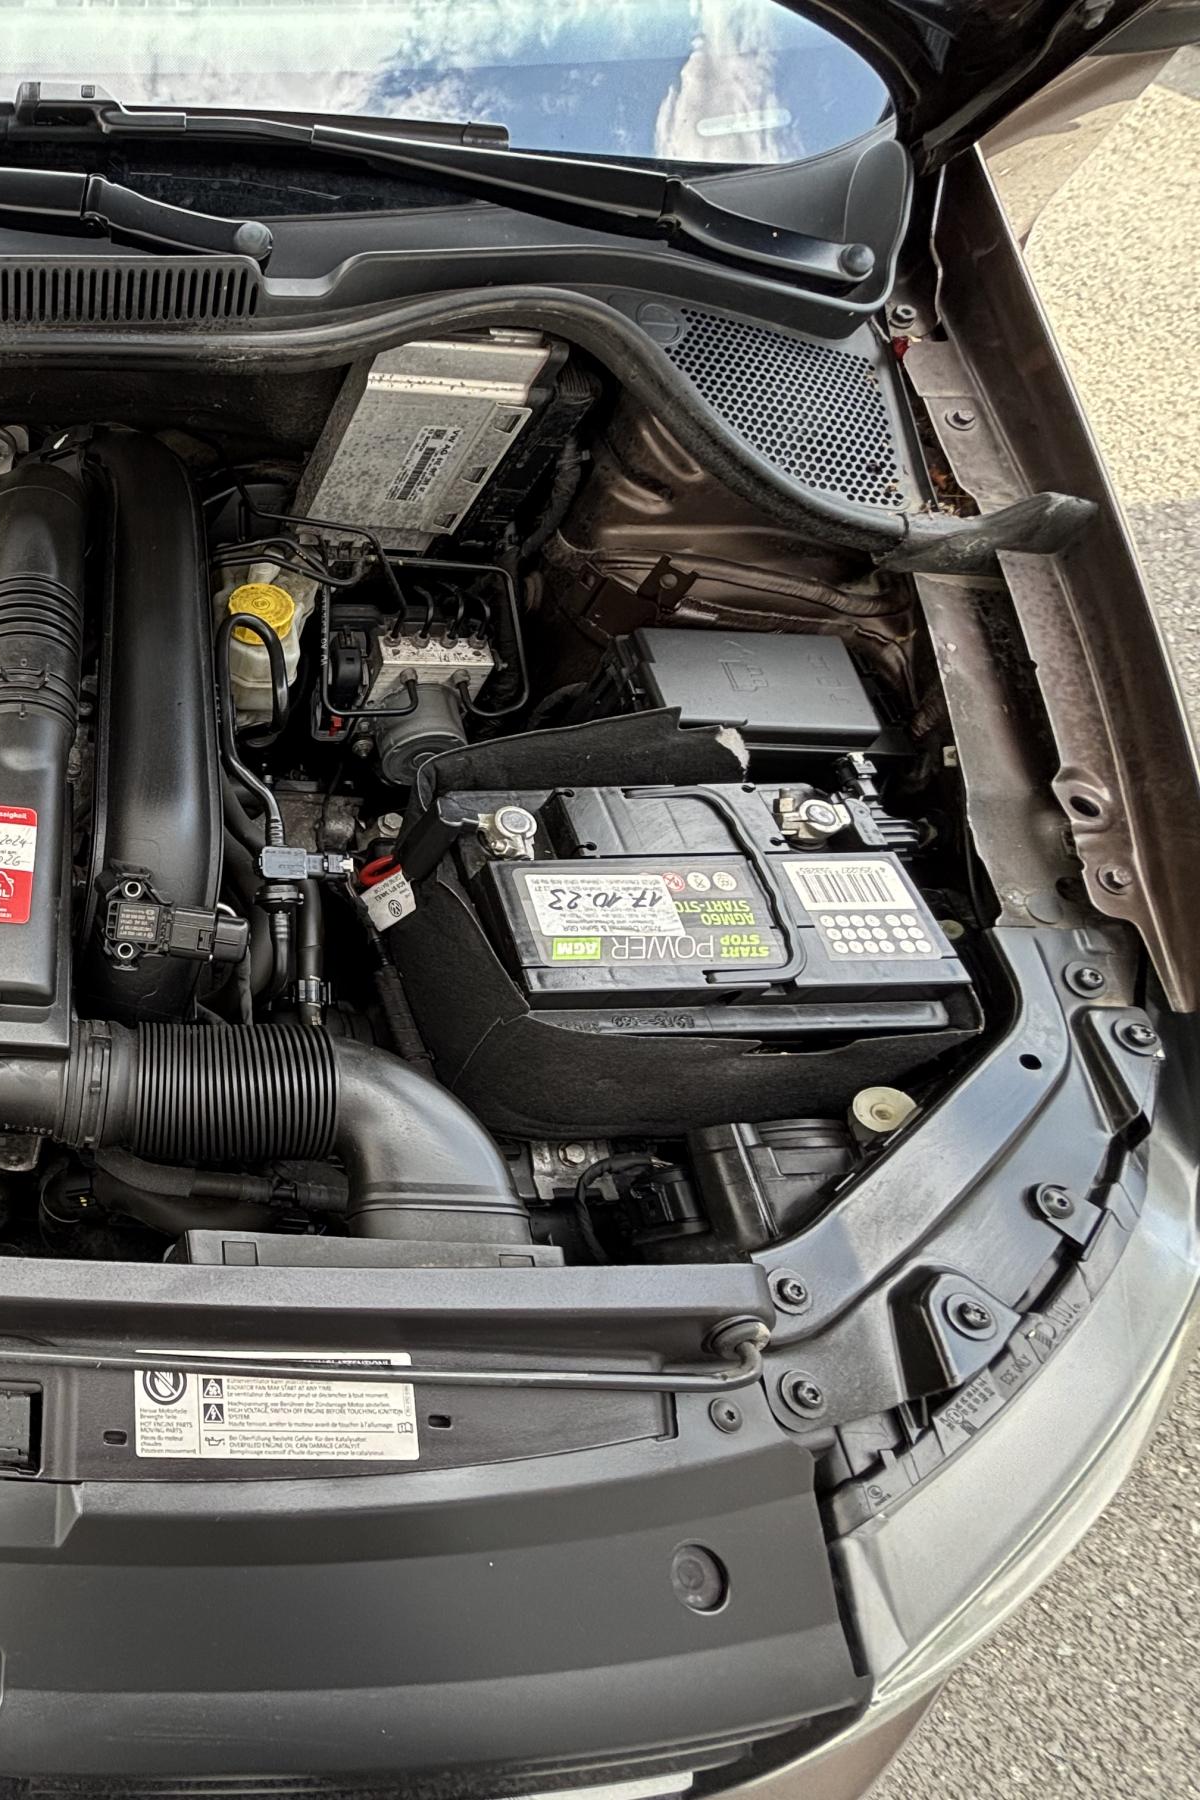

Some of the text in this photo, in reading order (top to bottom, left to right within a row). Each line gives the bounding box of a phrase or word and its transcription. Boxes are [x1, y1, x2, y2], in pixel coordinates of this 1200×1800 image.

[548, 889, 663, 911] 17.10.23
[673, 900, 751, 913] START-STO
[700, 913, 755, 926] AGM60
[720, 934, 760, 945] STOP
[556, 942, 597, 954] AGM
[611, 935, 714, 959] POWER
[720, 946, 769, 957] START
